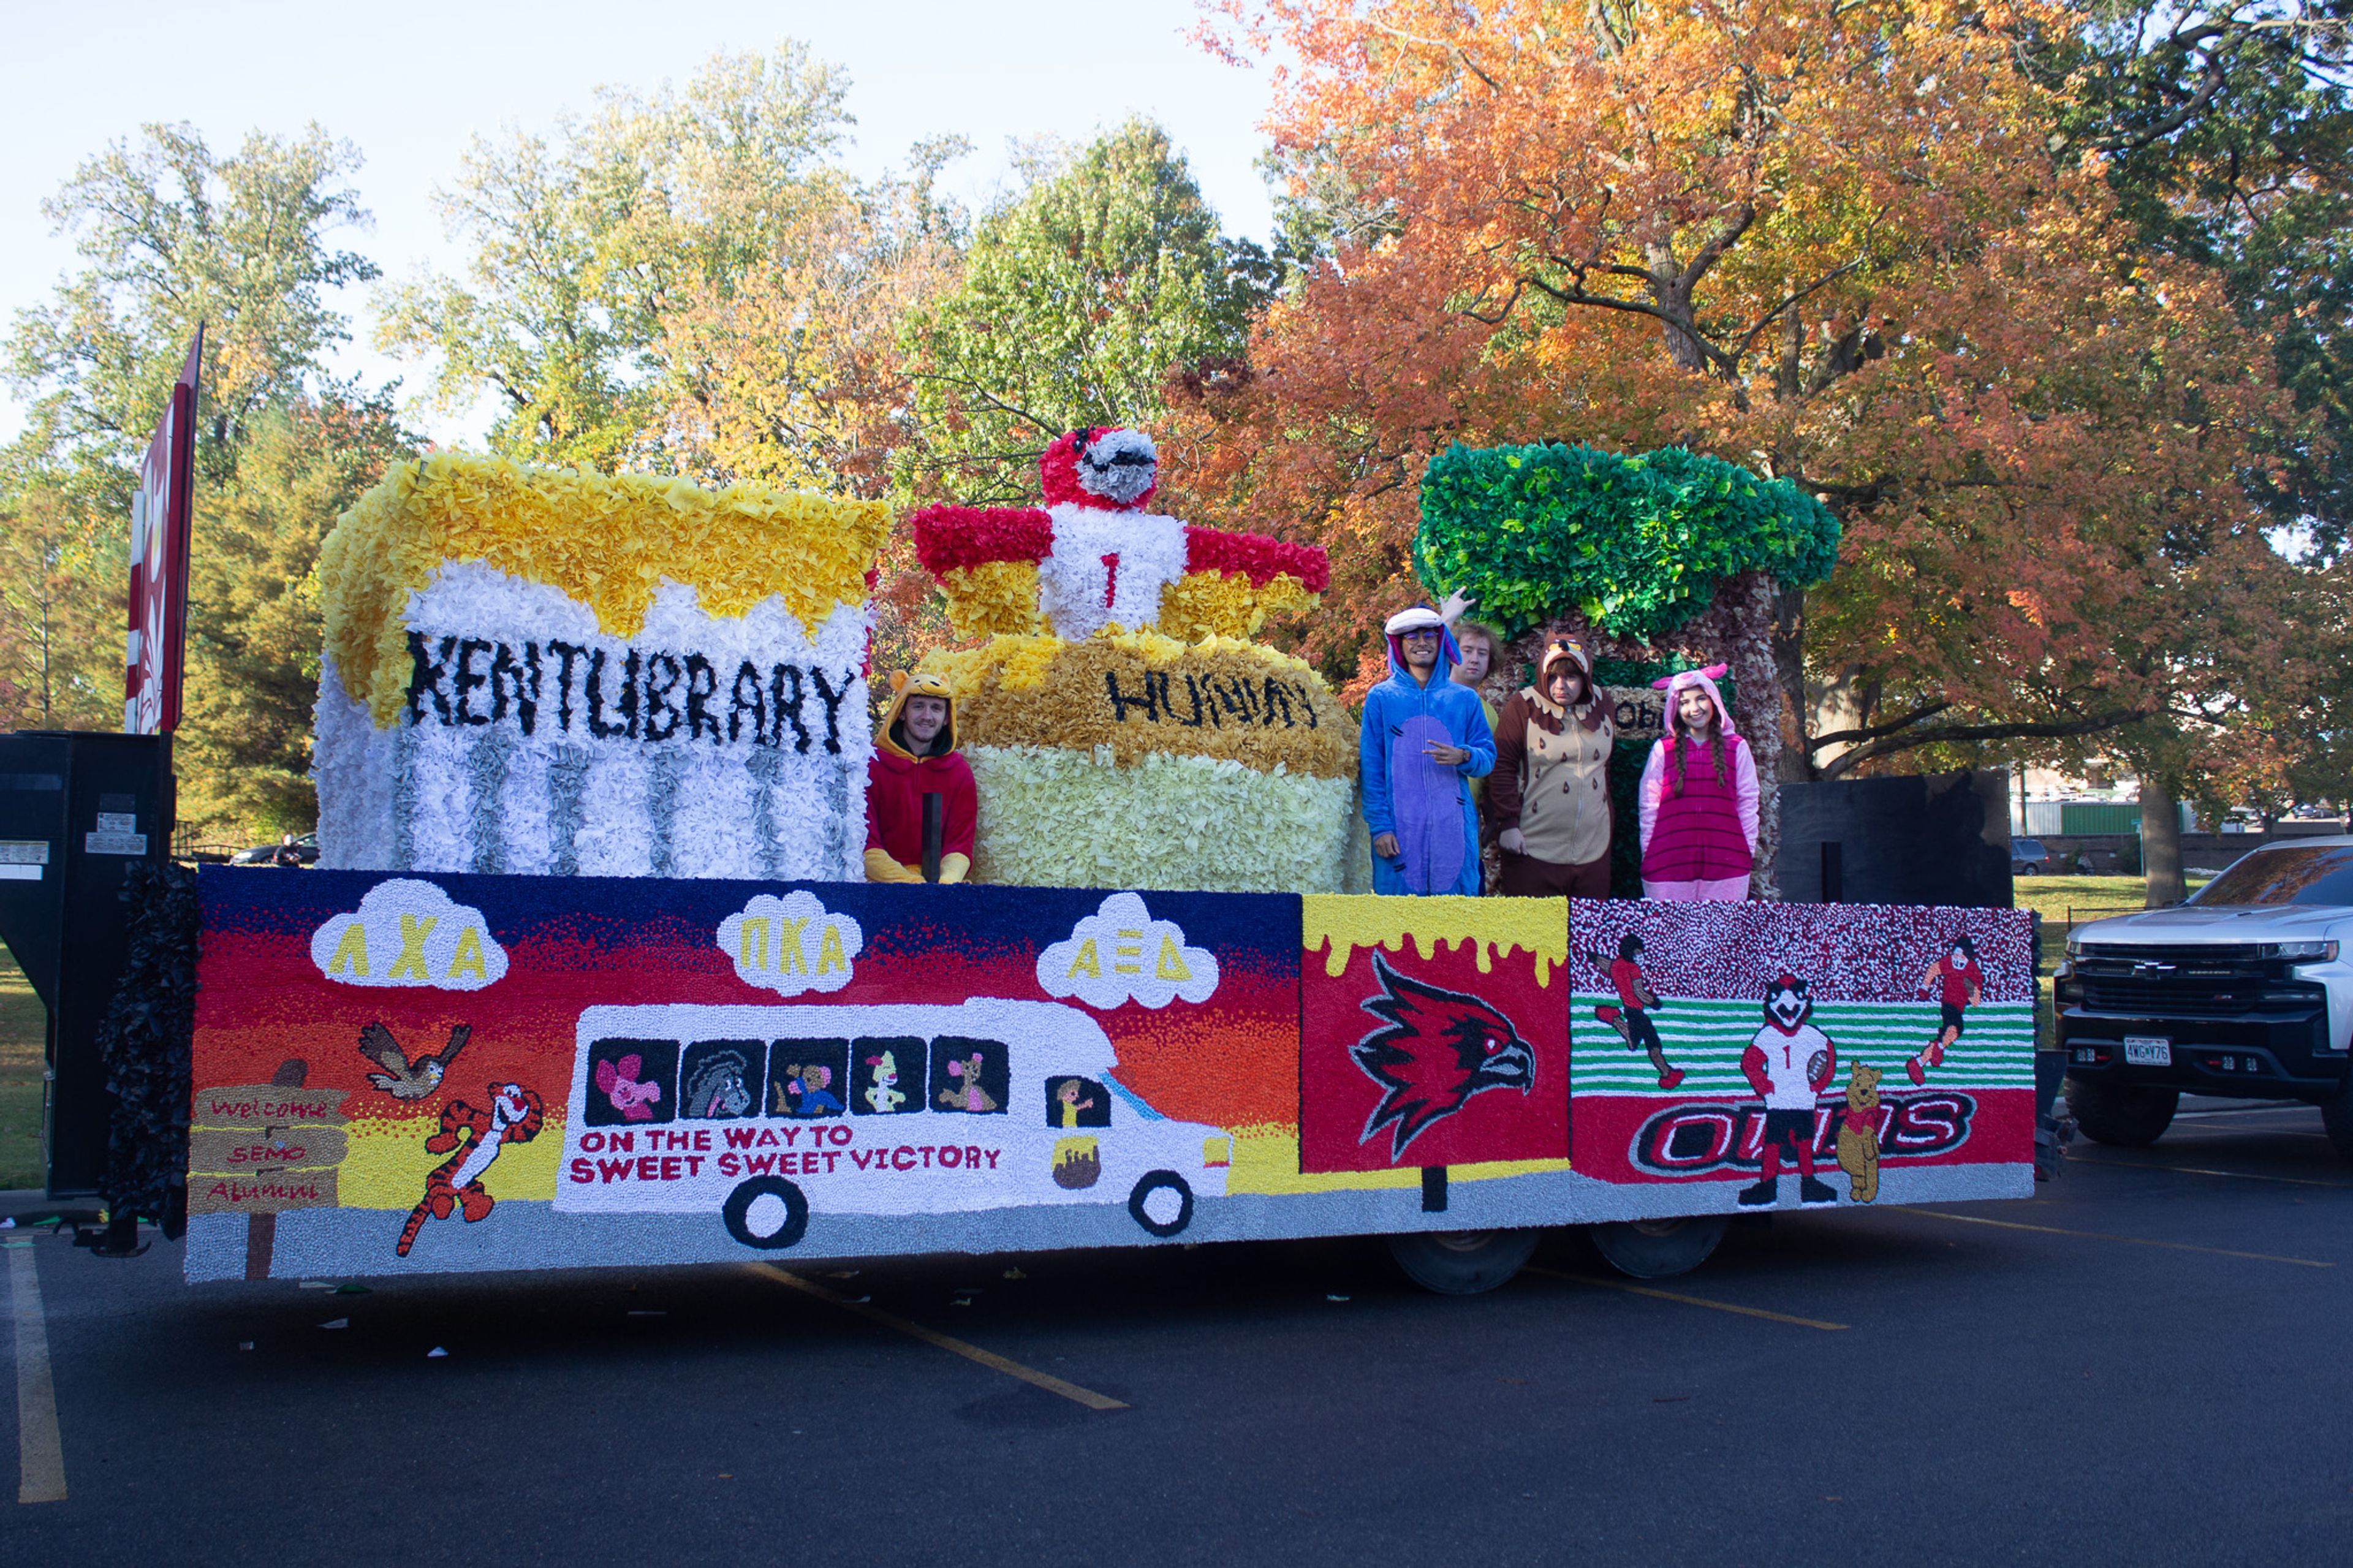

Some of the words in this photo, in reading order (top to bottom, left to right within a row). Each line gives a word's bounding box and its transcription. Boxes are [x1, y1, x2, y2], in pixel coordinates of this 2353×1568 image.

[1102, 553, 1120, 608] 1
[1782, 1045, 1791, 1070] 1
[211, 1099, 327, 1119] Welcome
[580, 1131, 634, 1153] ON
[645, 1129, 711, 1151] THE
[722, 1126, 800, 1149] WAY
[809, 1124, 854, 1146] TO
[227, 1145, 306, 1164] SEMO
[570, 1156, 705, 1184] SWEET
[718, 1151, 841, 1176] SWEET
[851, 1145, 1001, 1171] VICTORY
